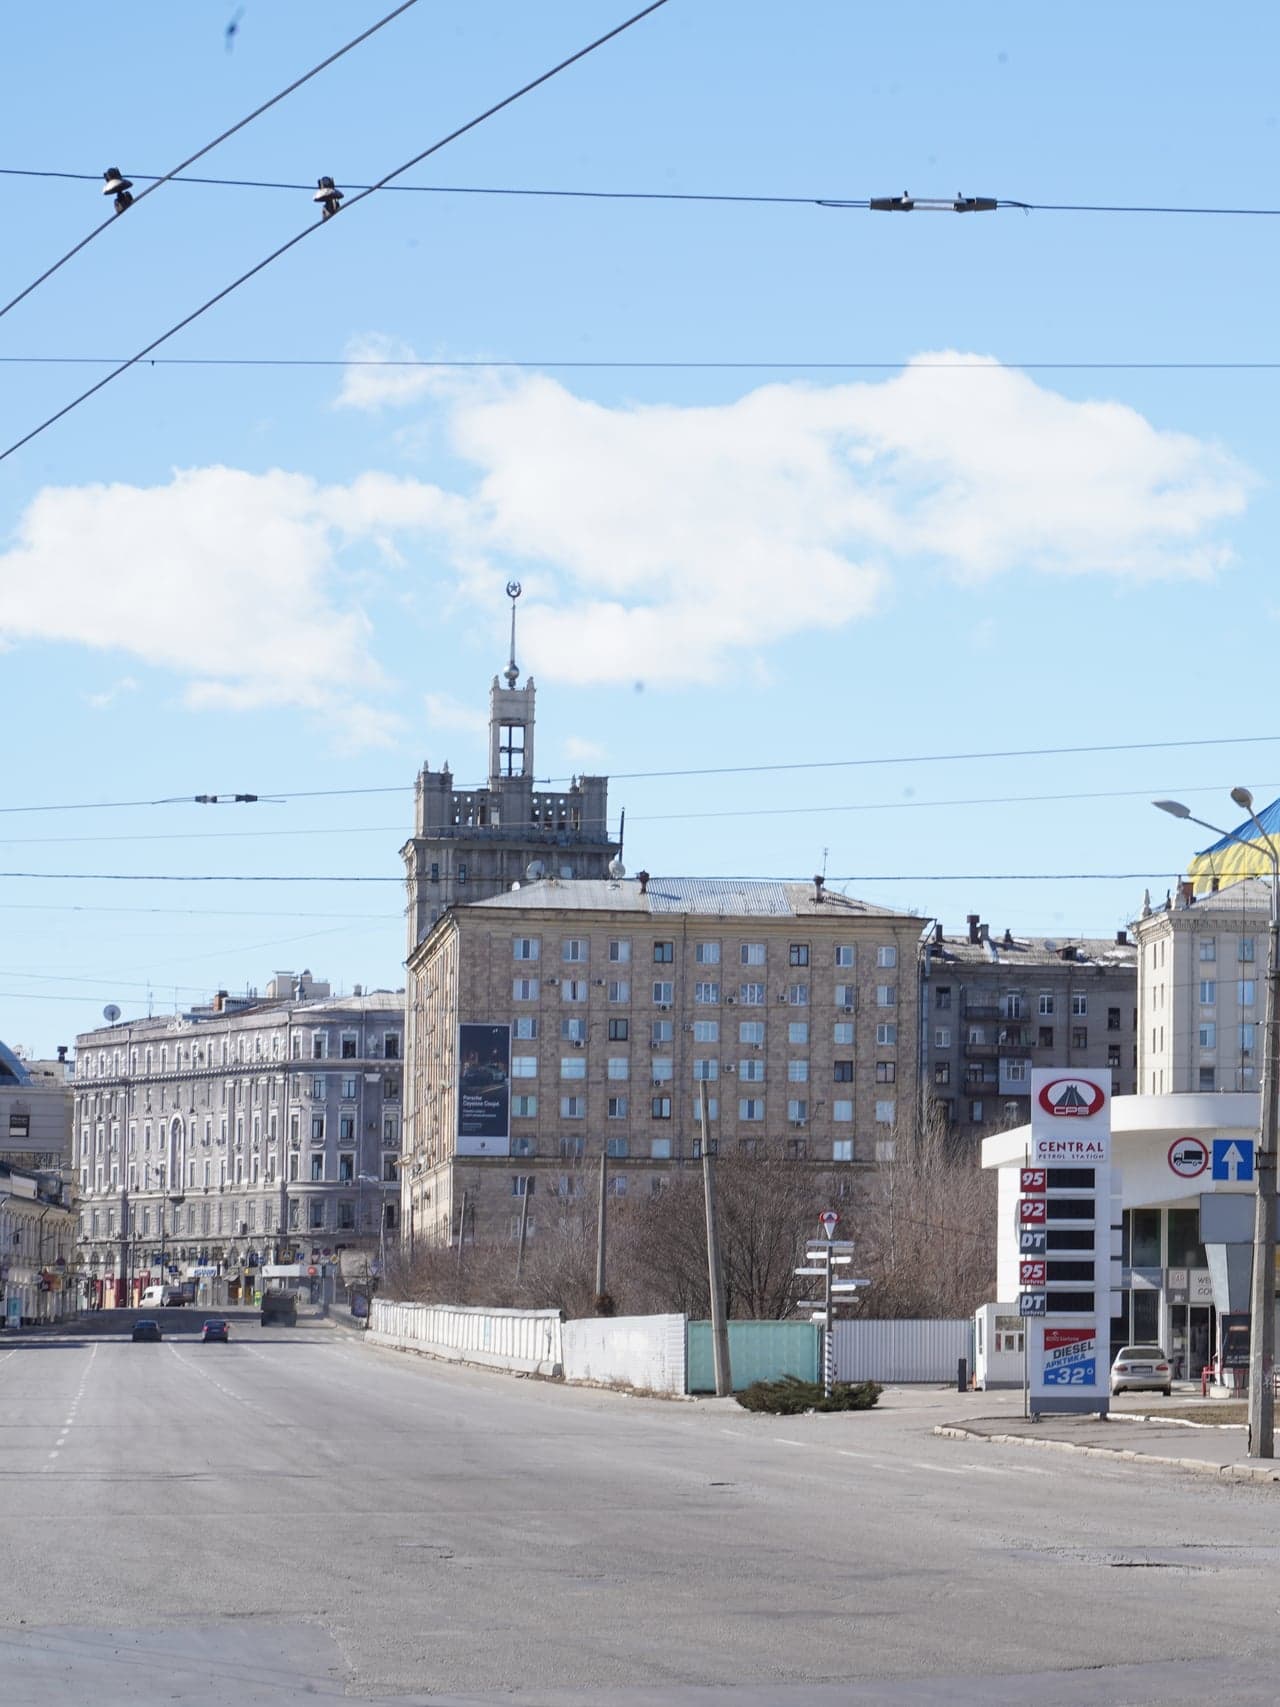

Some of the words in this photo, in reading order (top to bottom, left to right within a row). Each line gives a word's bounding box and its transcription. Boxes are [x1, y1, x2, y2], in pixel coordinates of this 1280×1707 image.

[1054, 1106, 1089, 1115] CPS
[1038, 1142, 1104, 1153] CENTRAL
[1022, 1172, 1044, 1186] 95
[1022, 1203, 1045, 1217] 92
[1021, 1233, 1045, 1248] DT
[1022, 1264, 1044, 1278] 95
[1021, 1295, 1045, 1310] DT
[1053, 1341, 1095, 1360] DIESEL
[1046, 1353, 1087, 1369] АРКТИКА
[1048, 1367, 1094, 1384] -32°
